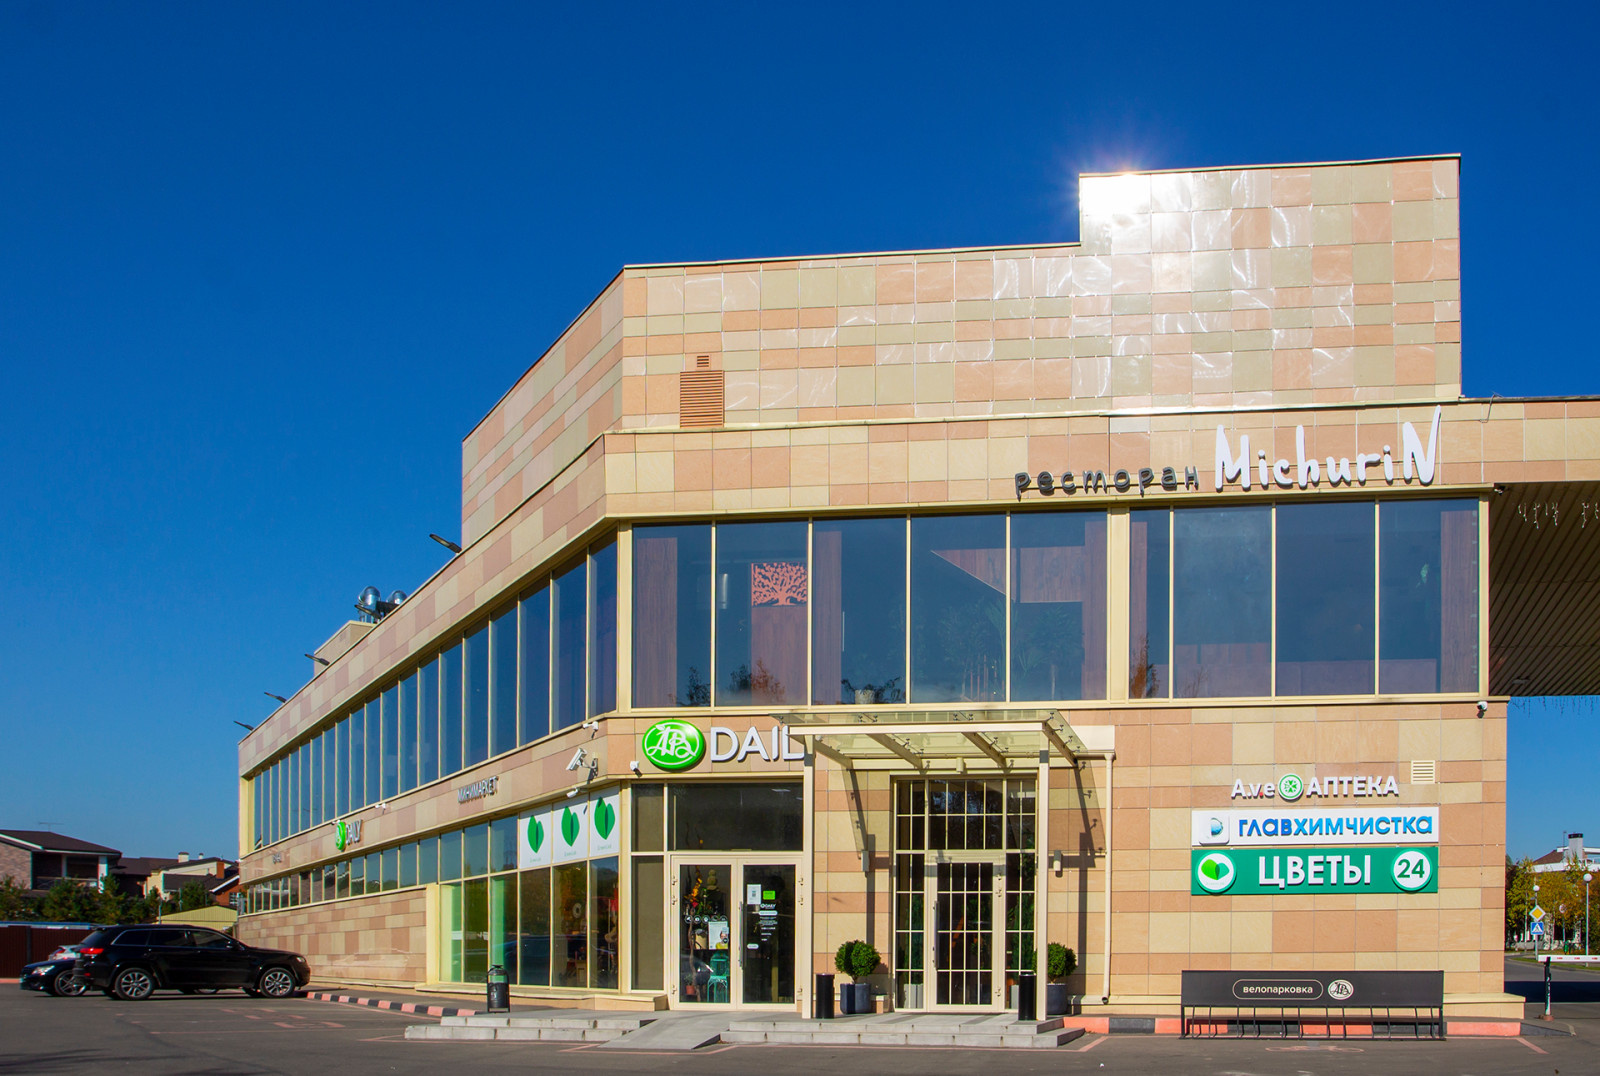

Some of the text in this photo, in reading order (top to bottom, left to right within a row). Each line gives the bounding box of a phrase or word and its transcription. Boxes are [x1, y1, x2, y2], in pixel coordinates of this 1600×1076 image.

[1014, 465, 1199, 500] ресторан
[711, 725, 806, 762] DAIL
[1306, 775, 1400, 798] АПТЕКА
[1258, 855, 1425, 890] ЦВЕТЫ 24
[1243, 985, 1313, 996] велопарковка
